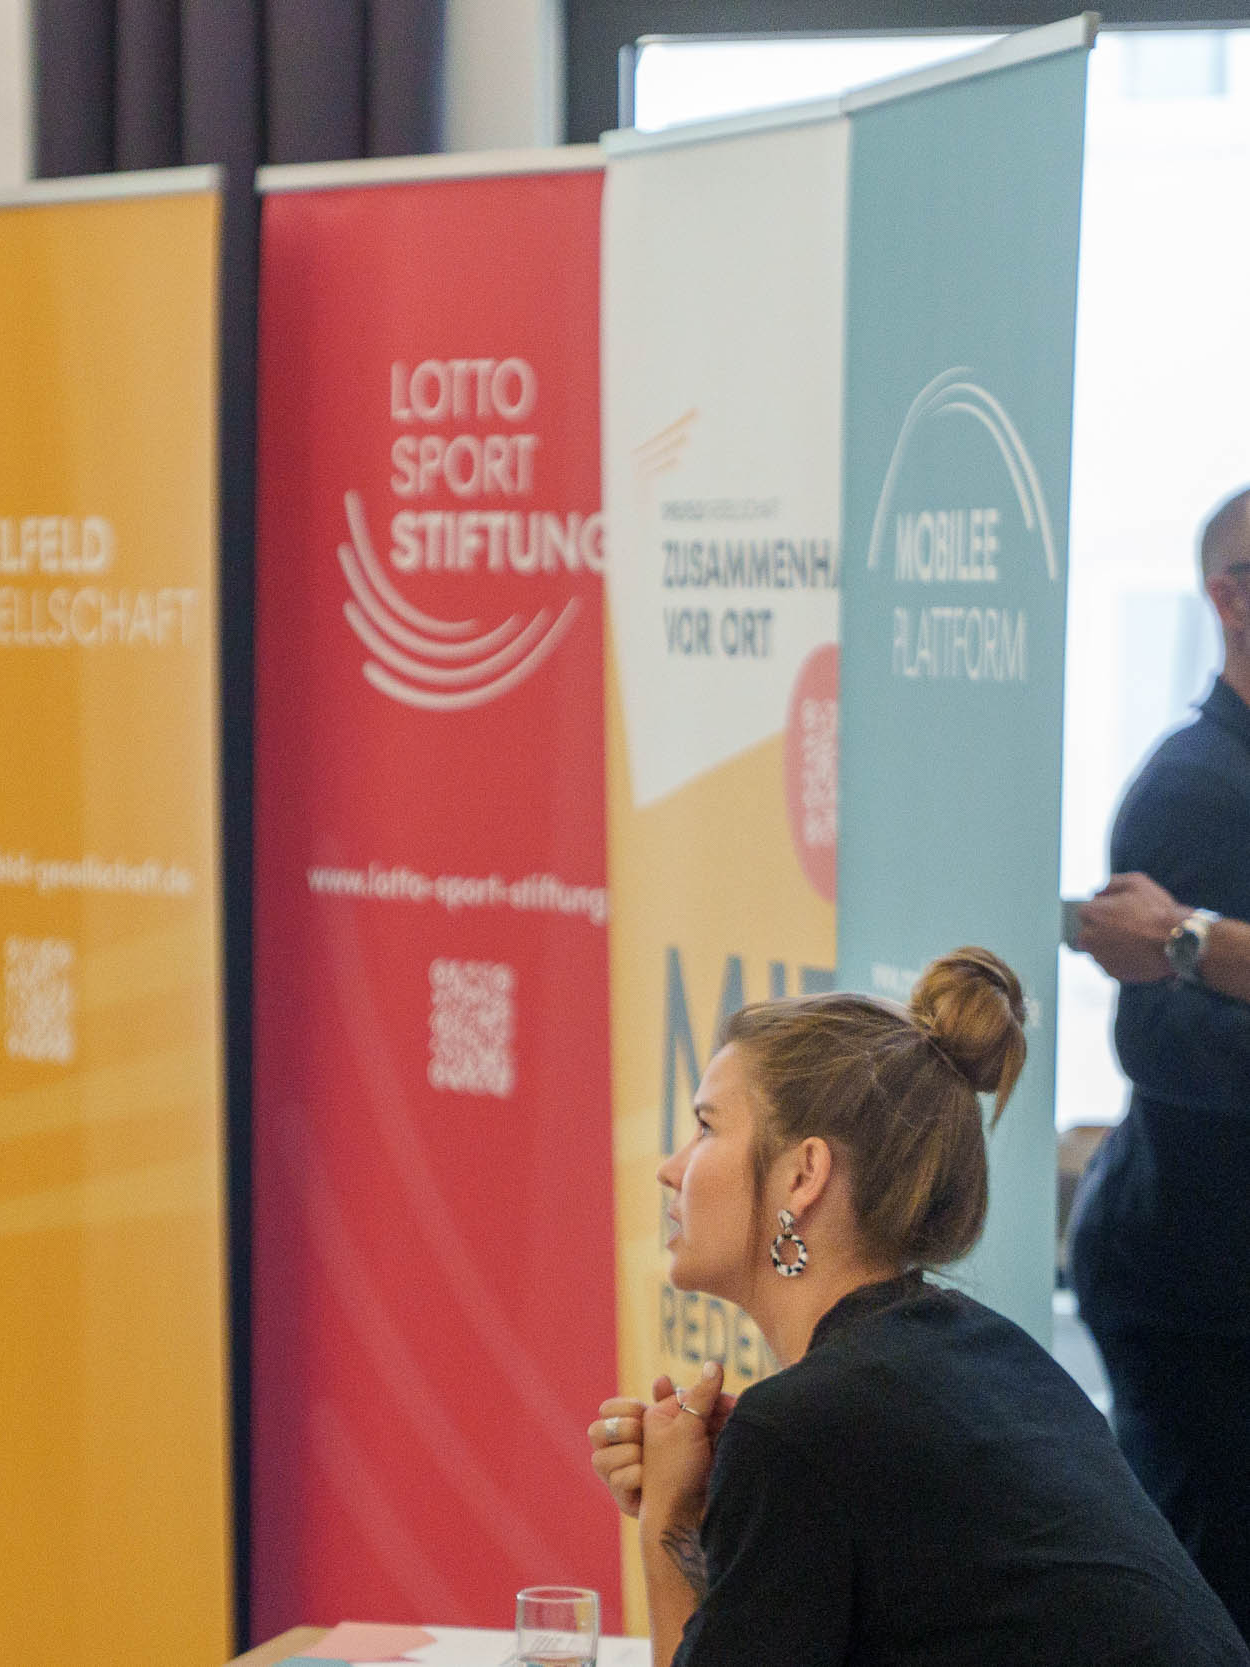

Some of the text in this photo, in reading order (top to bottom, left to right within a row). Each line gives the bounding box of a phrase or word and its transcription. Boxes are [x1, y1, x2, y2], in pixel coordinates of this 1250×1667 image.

[390, 358, 536, 421] LOTTO
[389, 433, 539, 497] SPORT
[662, 607, 776, 660] VOR ORT
[892, 606, 1028, 682] PLATTFORM
